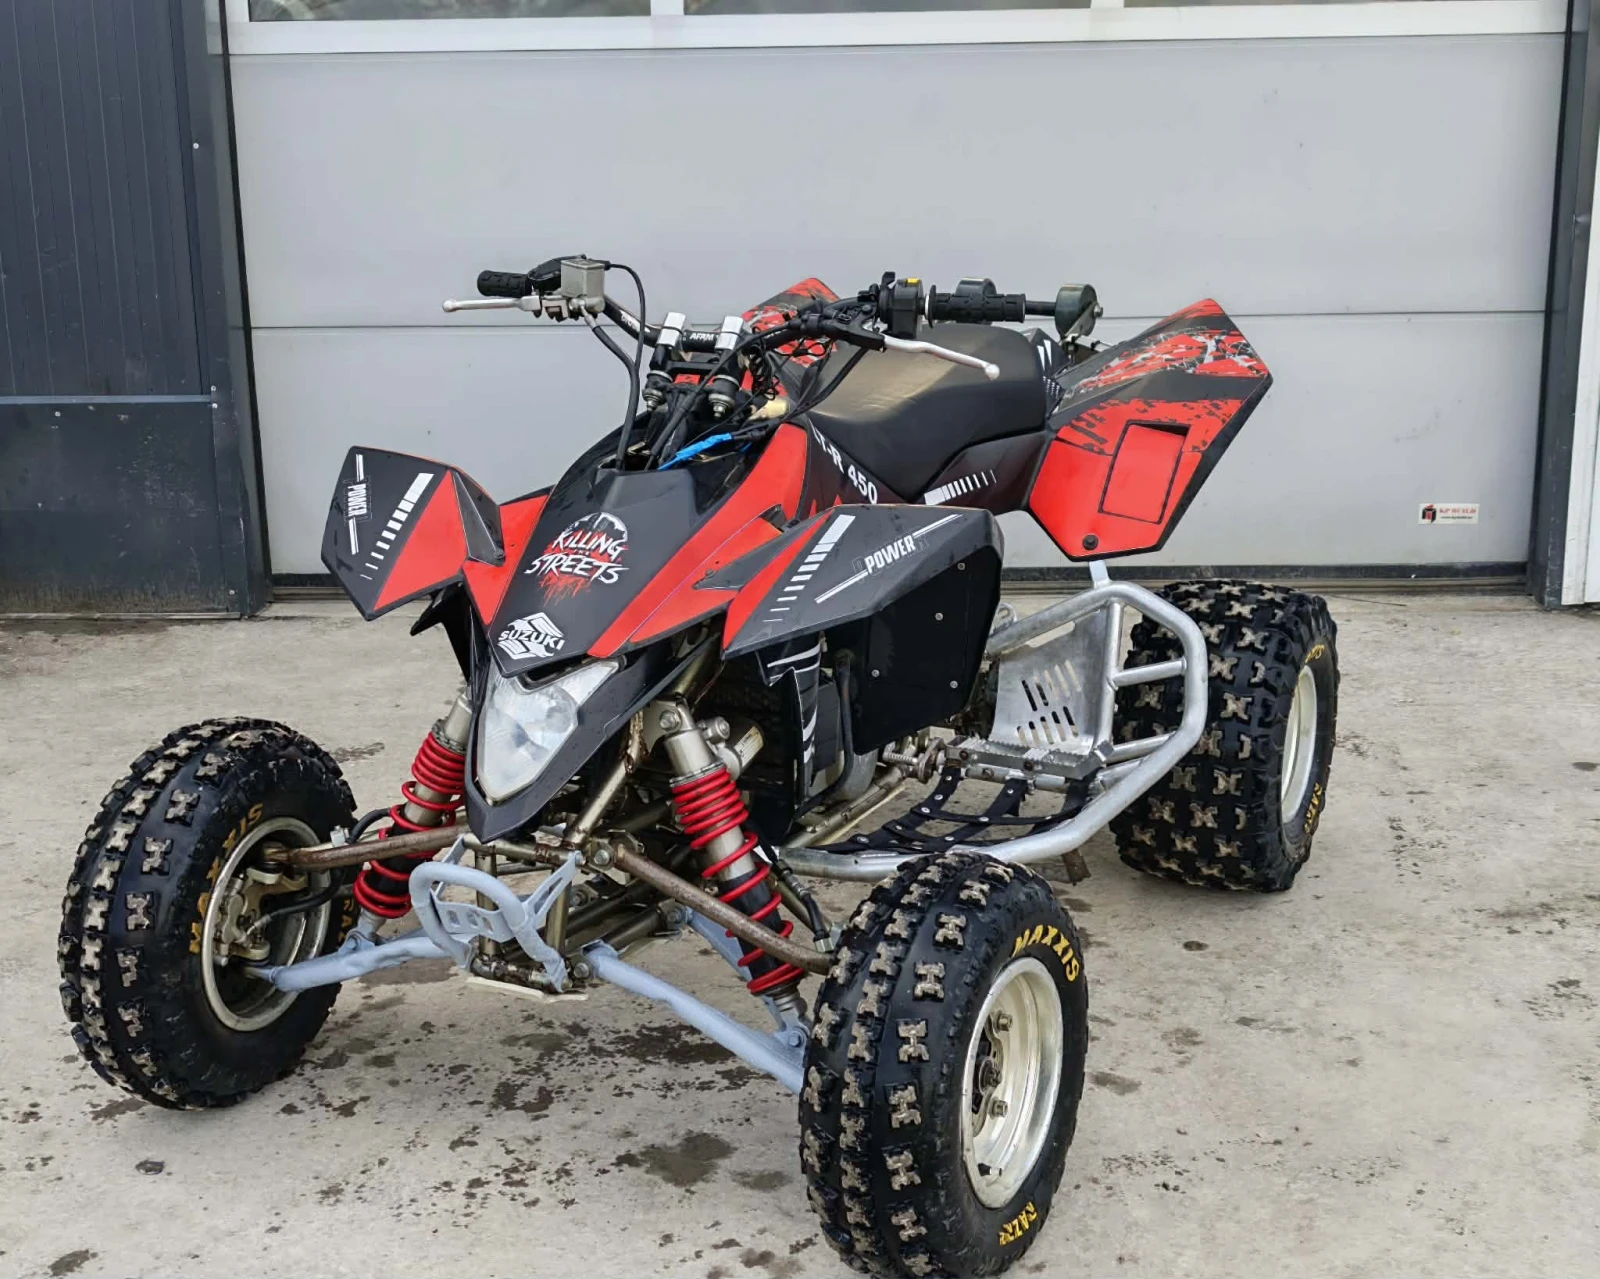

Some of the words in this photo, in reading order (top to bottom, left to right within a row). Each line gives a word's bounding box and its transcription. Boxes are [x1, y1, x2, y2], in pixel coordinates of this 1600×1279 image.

[347, 483, 367, 517] POWER
[847, 463, 878, 505] 450
[551, 530, 628, 562] KILLING
[864, 534, 916, 574] POWER
[524, 551, 630, 584] STREETS
[498, 629, 566, 651] SUZUKI
[1011, 924, 1080, 982] MAXXIS
